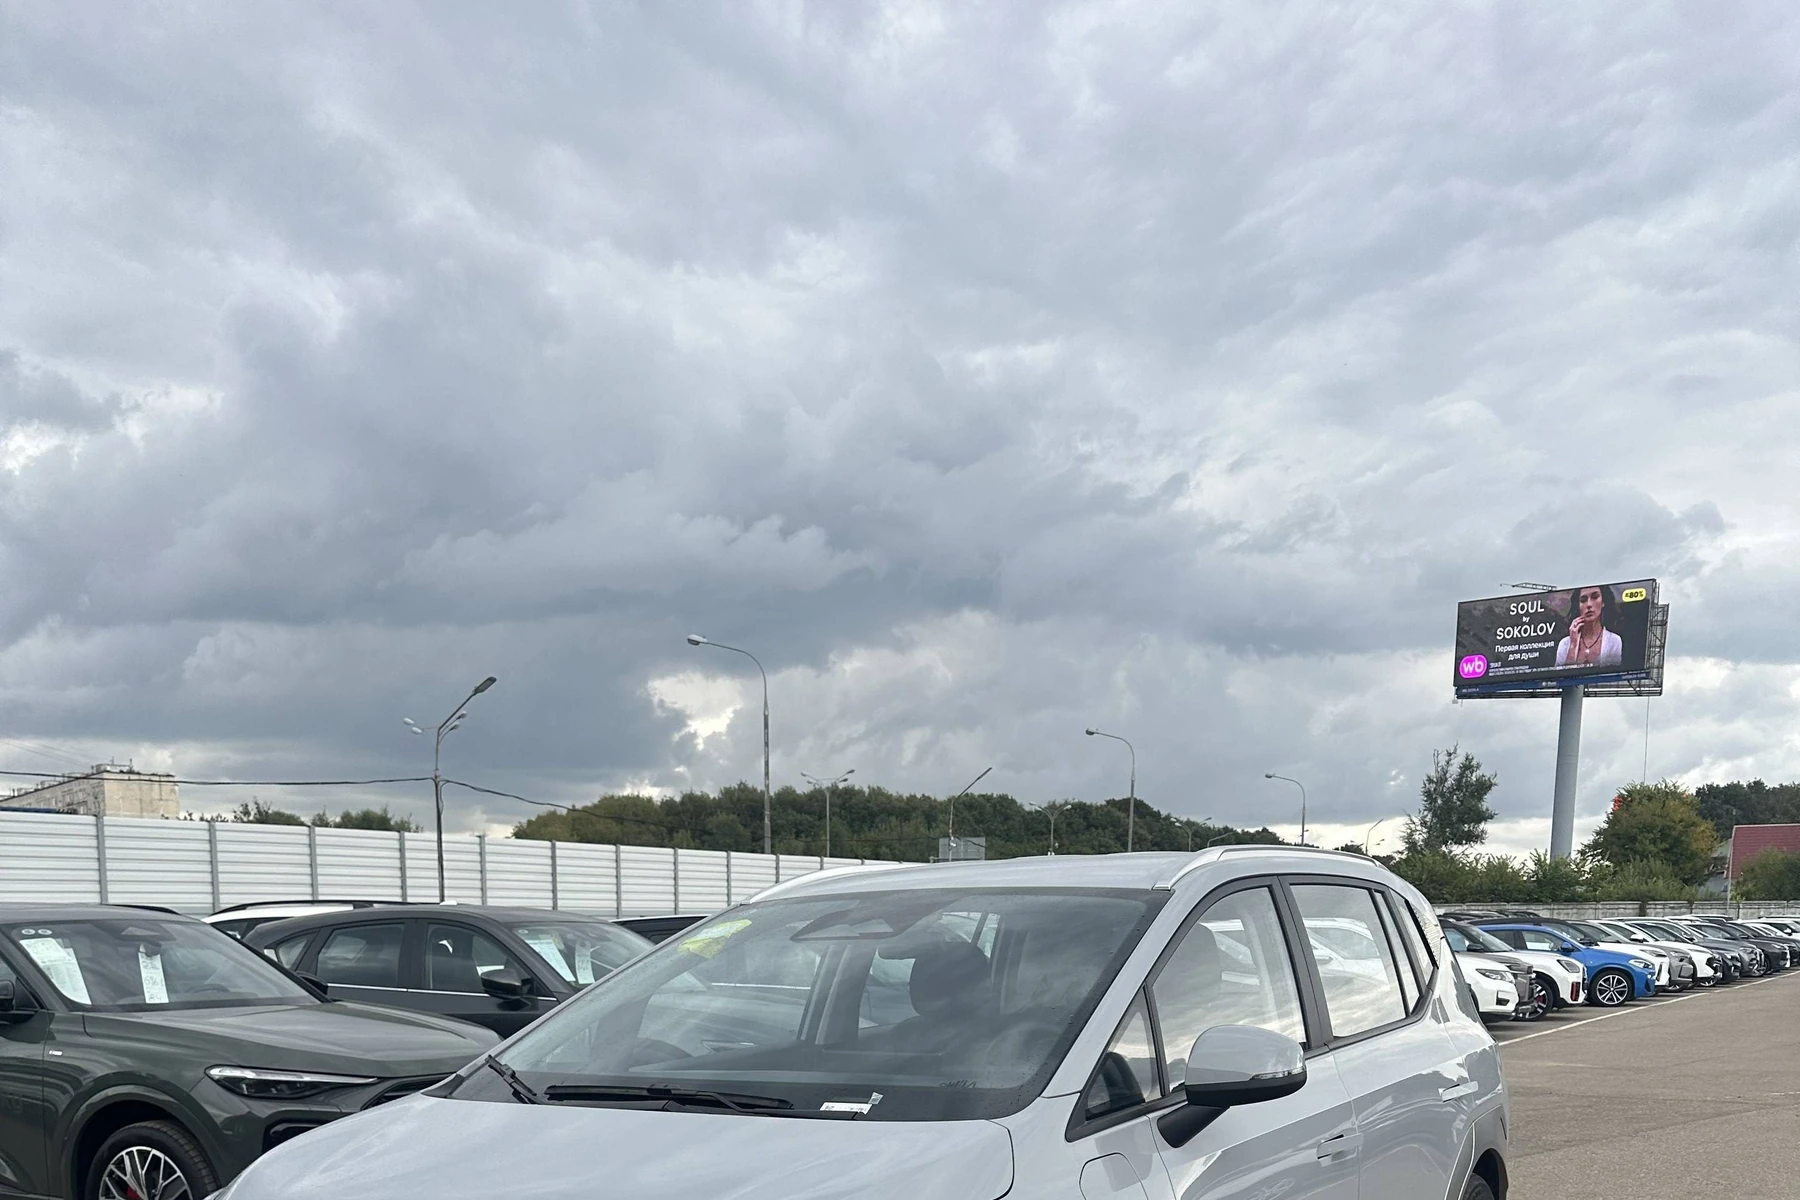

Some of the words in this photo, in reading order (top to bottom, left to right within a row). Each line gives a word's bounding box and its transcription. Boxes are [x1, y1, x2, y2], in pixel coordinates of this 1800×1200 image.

[1509, 600, 1545, 616] SOUL
[1496, 621, 1556, 640] SOKOLOV
[1495, 643, 1519, 653] Первая
[1519, 641, 1555, 650] коллекция
[1507, 652, 1521, 661] для
[1520, 651, 1540, 660] души
[1463, 658, 1485, 674] wb
